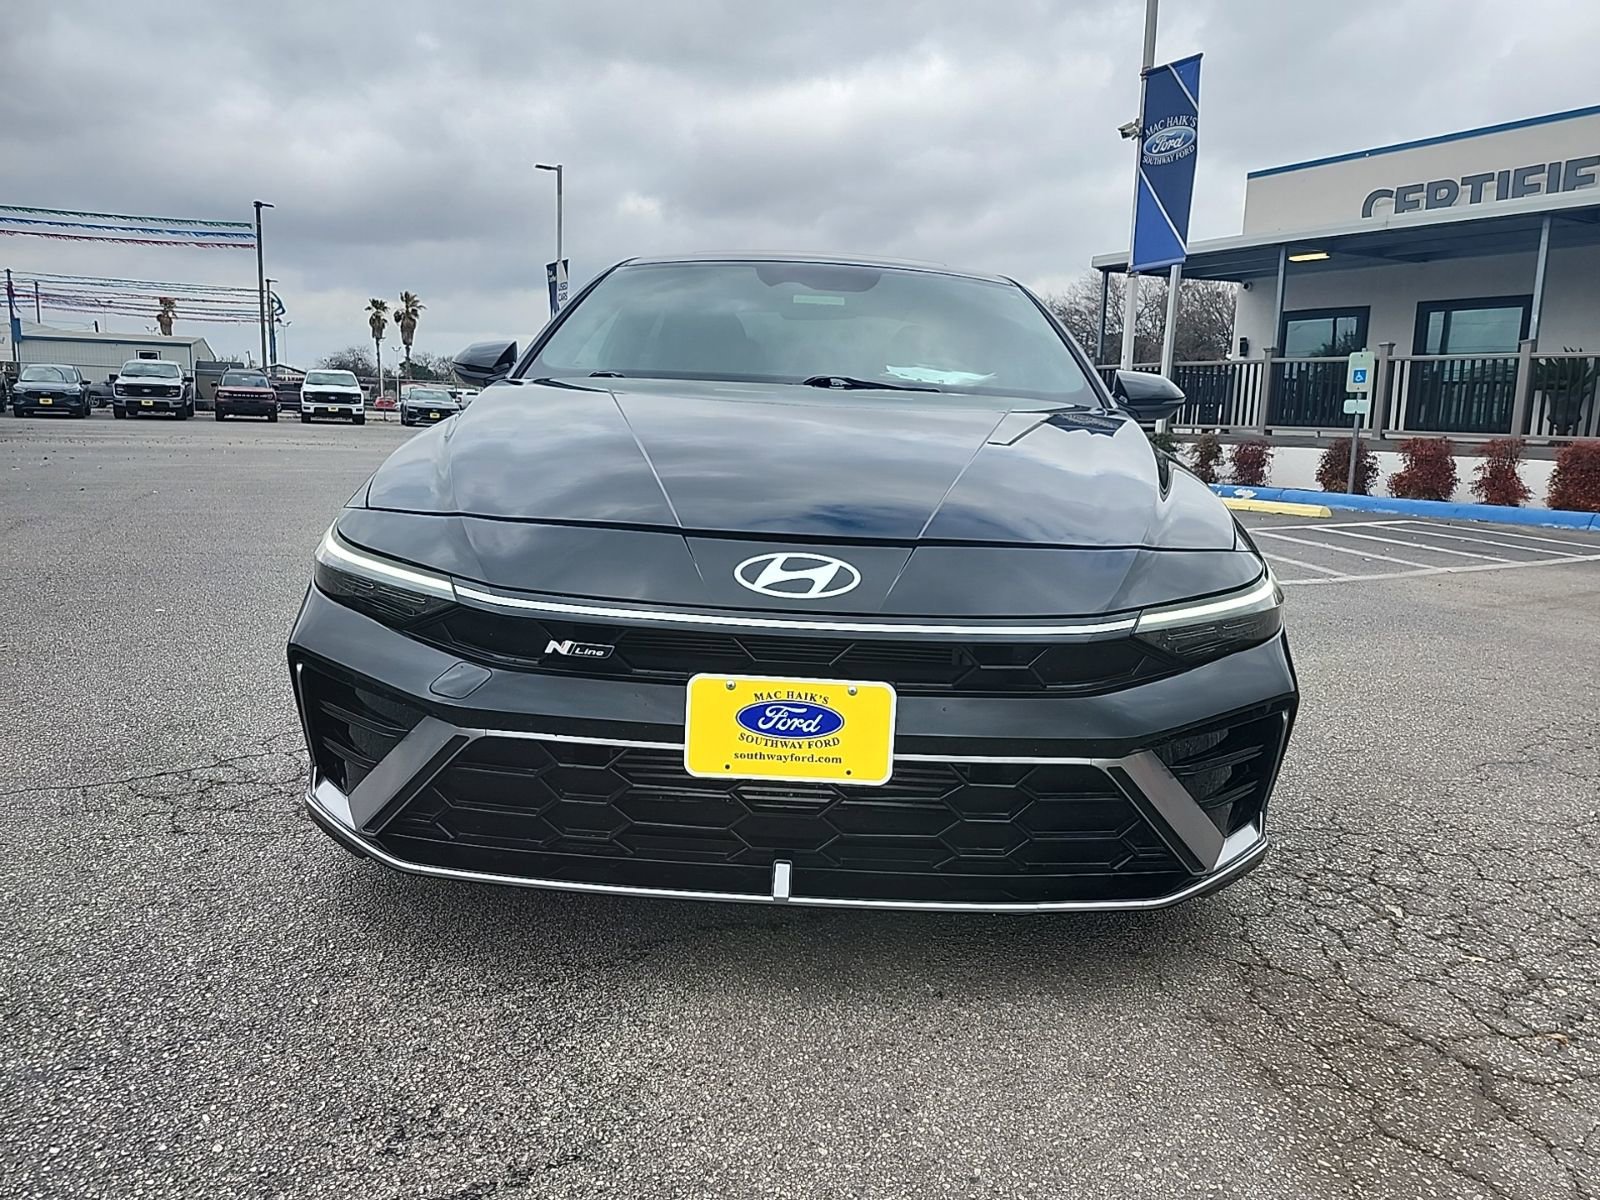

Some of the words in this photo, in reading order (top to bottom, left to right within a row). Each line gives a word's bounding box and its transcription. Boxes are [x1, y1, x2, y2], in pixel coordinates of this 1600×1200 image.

[1145, 119, 1165, 138] MAC
[1166, 115, 1197, 128] HAIK'S
[1152, 131, 1185, 153] Ford
[1142, 153, 1175, 165] SOUTHWAY
[1175, 144, 1195, 160] FORD
[574, 647, 605, 656] Line
[753, 690, 782, 702] MAC
[786, 690, 830, 705] HAIK'S
[758, 705, 824, 733] Ford
[738, 732, 804, 749] SOUTHWAY
[807, 736, 841, 749] FORD
[733, 751, 843, 764] southwayford.com
